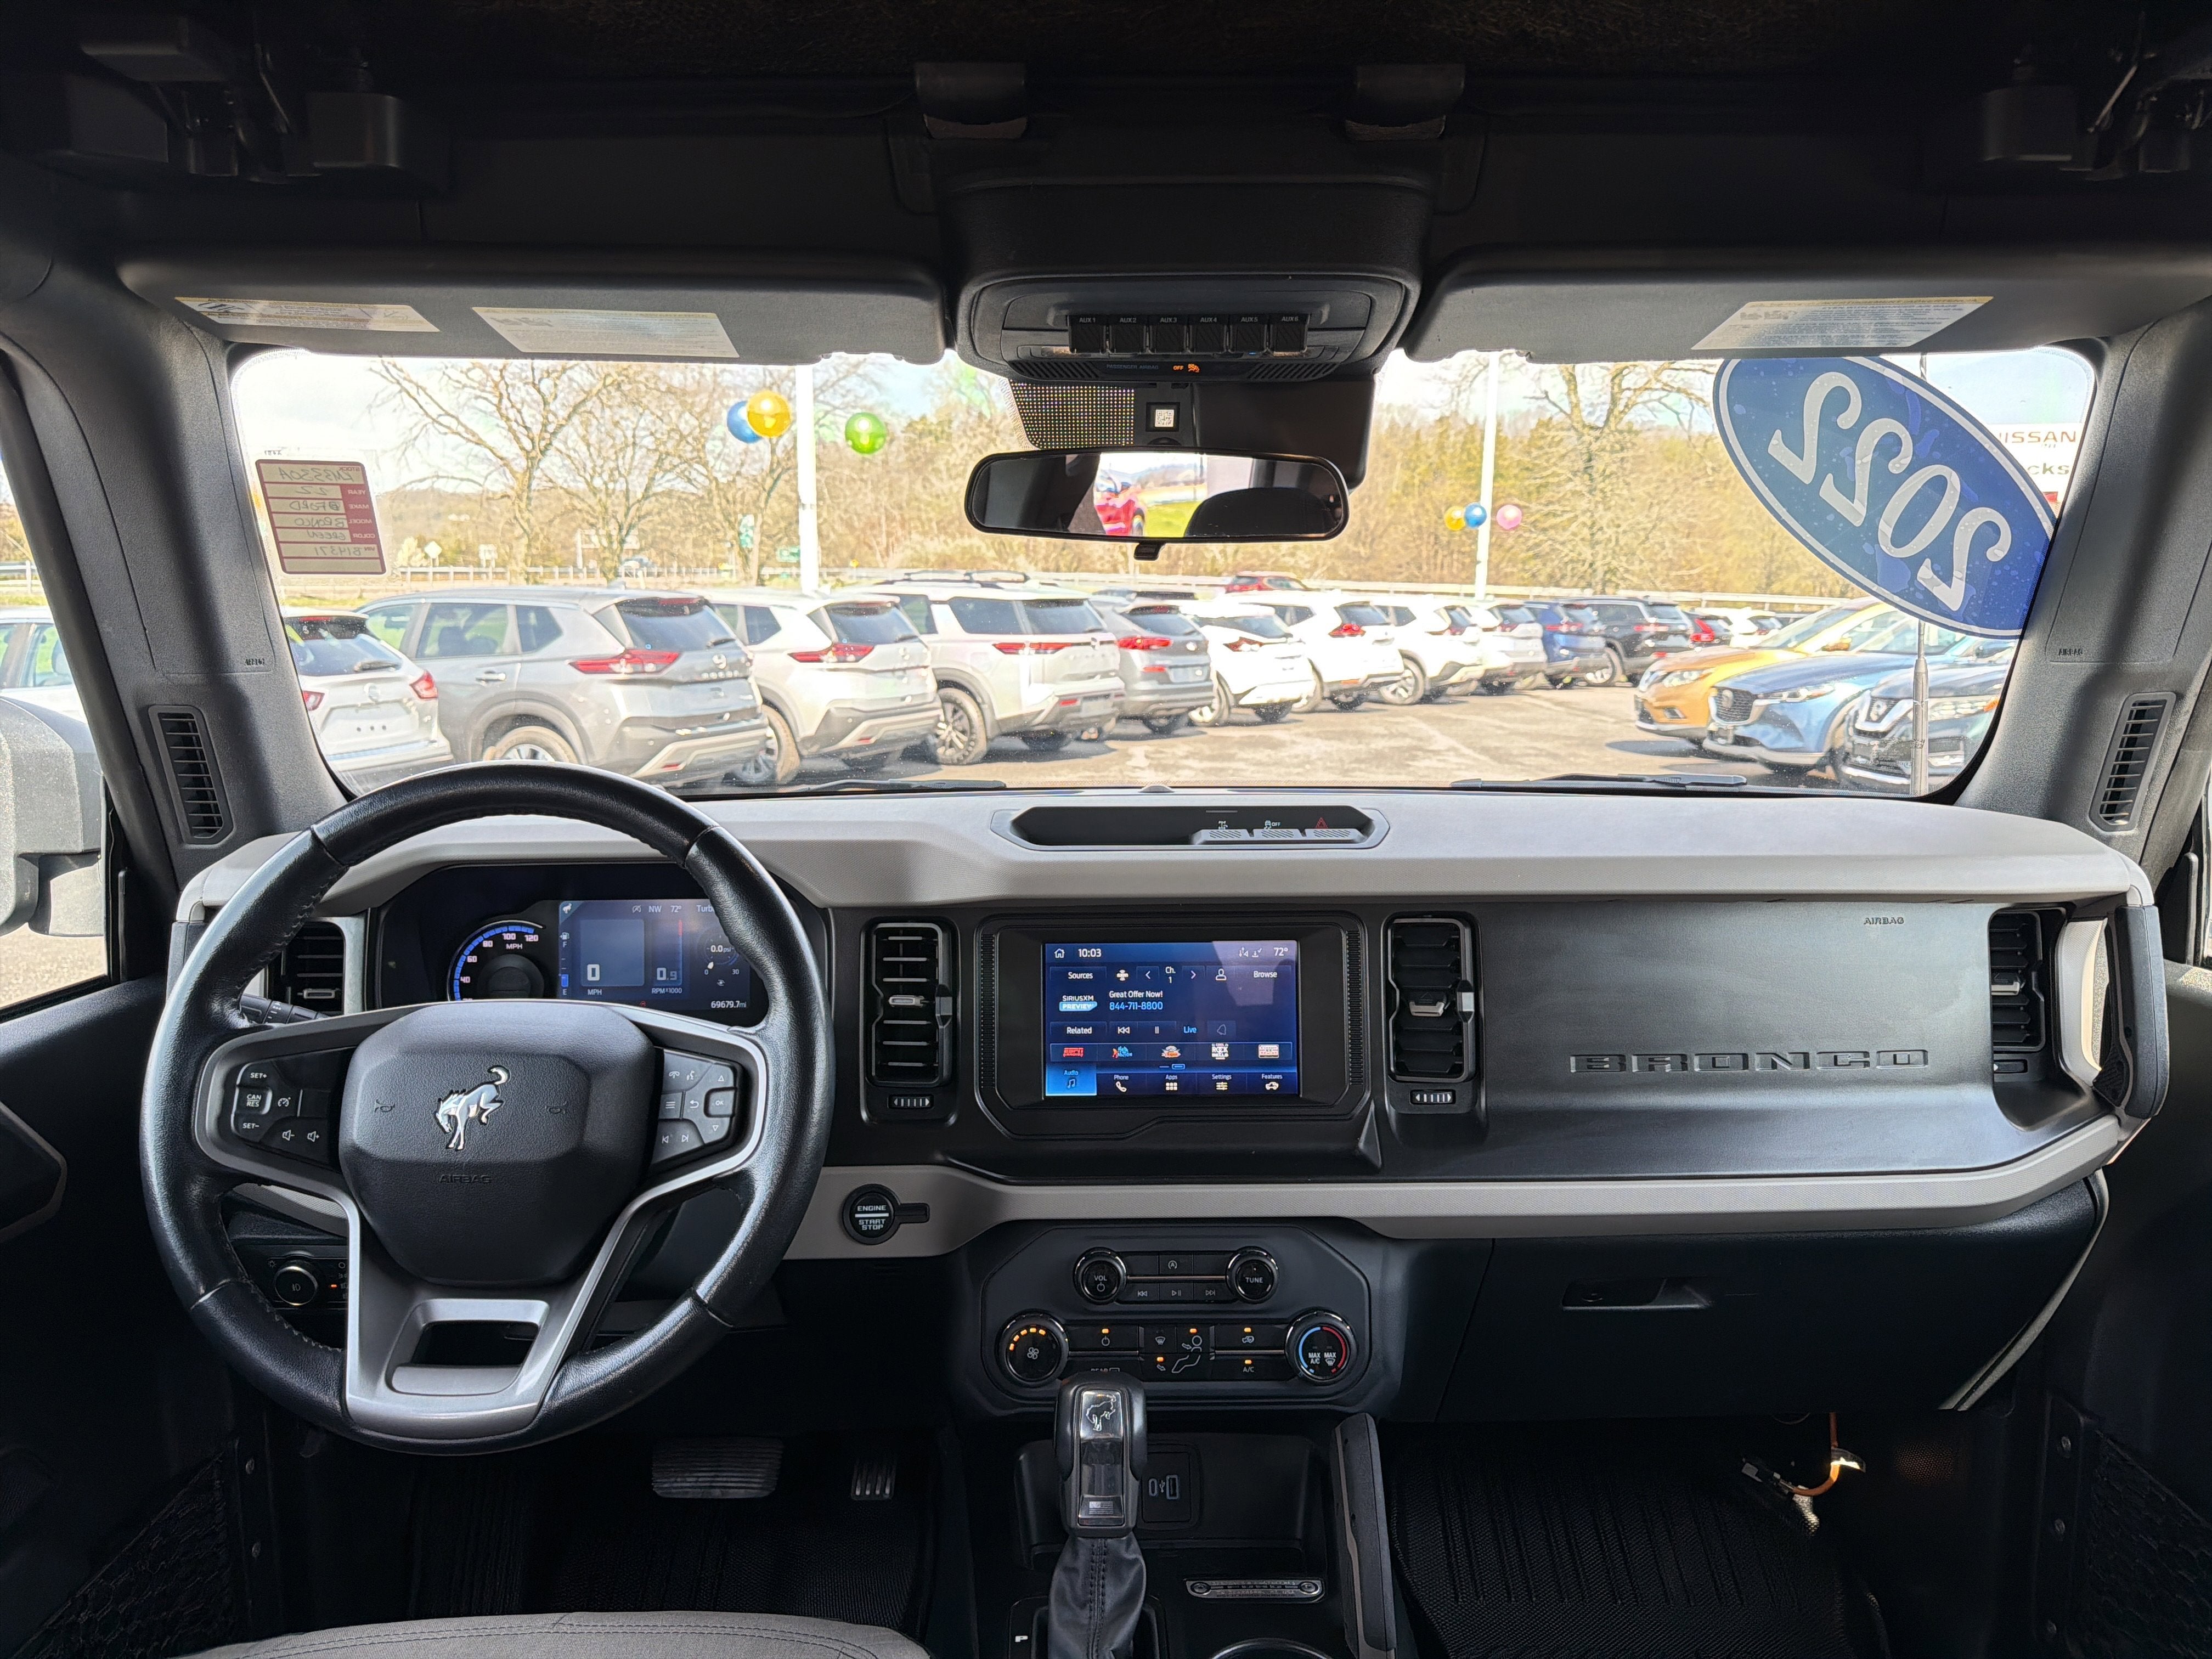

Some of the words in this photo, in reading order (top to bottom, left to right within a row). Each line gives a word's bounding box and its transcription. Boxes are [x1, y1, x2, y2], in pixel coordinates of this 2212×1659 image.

[1863, 917, 1904, 925] AIRBAG
[1078, 949, 1102, 958] 10:03
[1273, 947, 1289, 956] 72°
[587, 964, 600, 981] 0
[1109, 1002, 1163, 1011] 844-711-8800
[1570, 1049, 1929, 1073] BRONCO
[439, 1174, 492, 1183] AIRBAG
